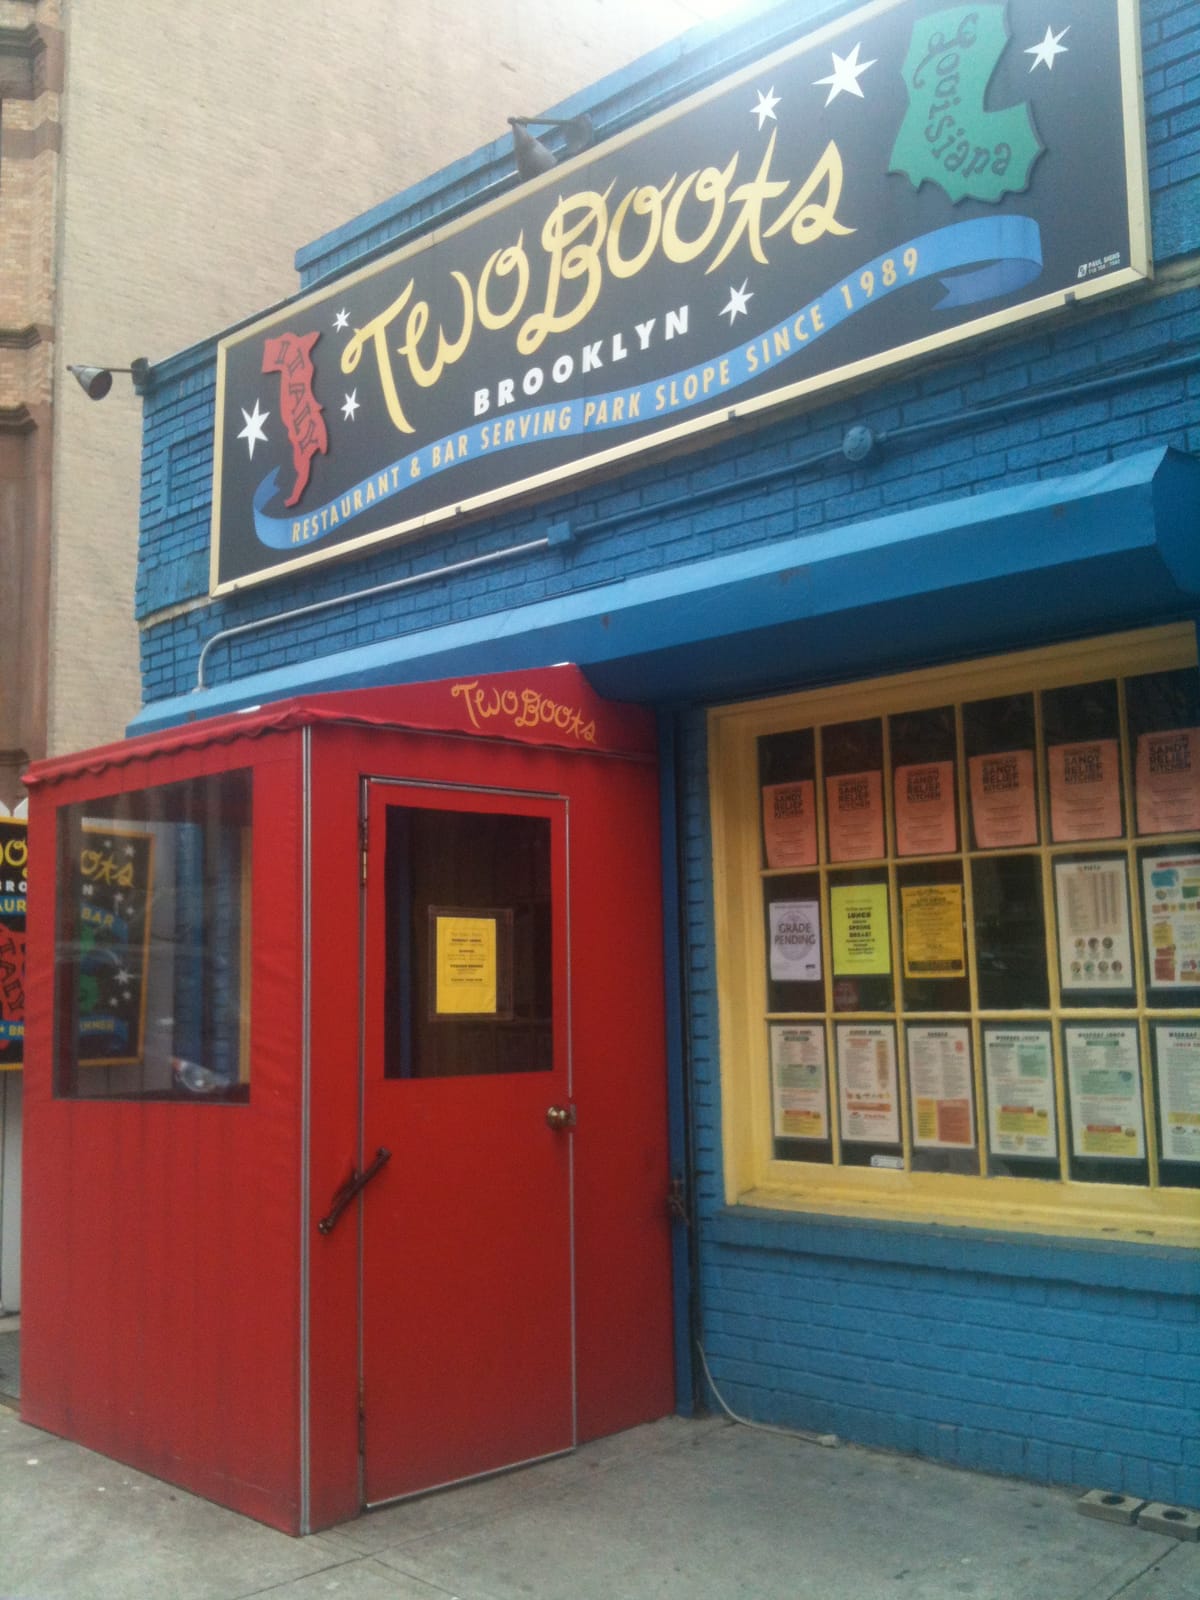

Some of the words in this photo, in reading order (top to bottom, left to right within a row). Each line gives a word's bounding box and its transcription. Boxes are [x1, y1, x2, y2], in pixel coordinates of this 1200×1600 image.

[913, 11, 1012, 178] Louisiana
[274, 341, 319, 455] ITALY
[291, 465, 400, 543] RESTAURANT
[410, 456, 422, 478] &
[432, 437, 470, 469] BAR
[480, 405, 572, 450] SERVING
[583, 387, 642, 427] PARK
[655, 359, 731, 411] SLOPE
[745, 304, 826, 373] SINCE
[840, 247, 919, 309] 1989
[473, 305, 690, 417] BROOKLYN
[774, 934, 816, 945] PENDING
[778, 922, 812, 934] GRADE
